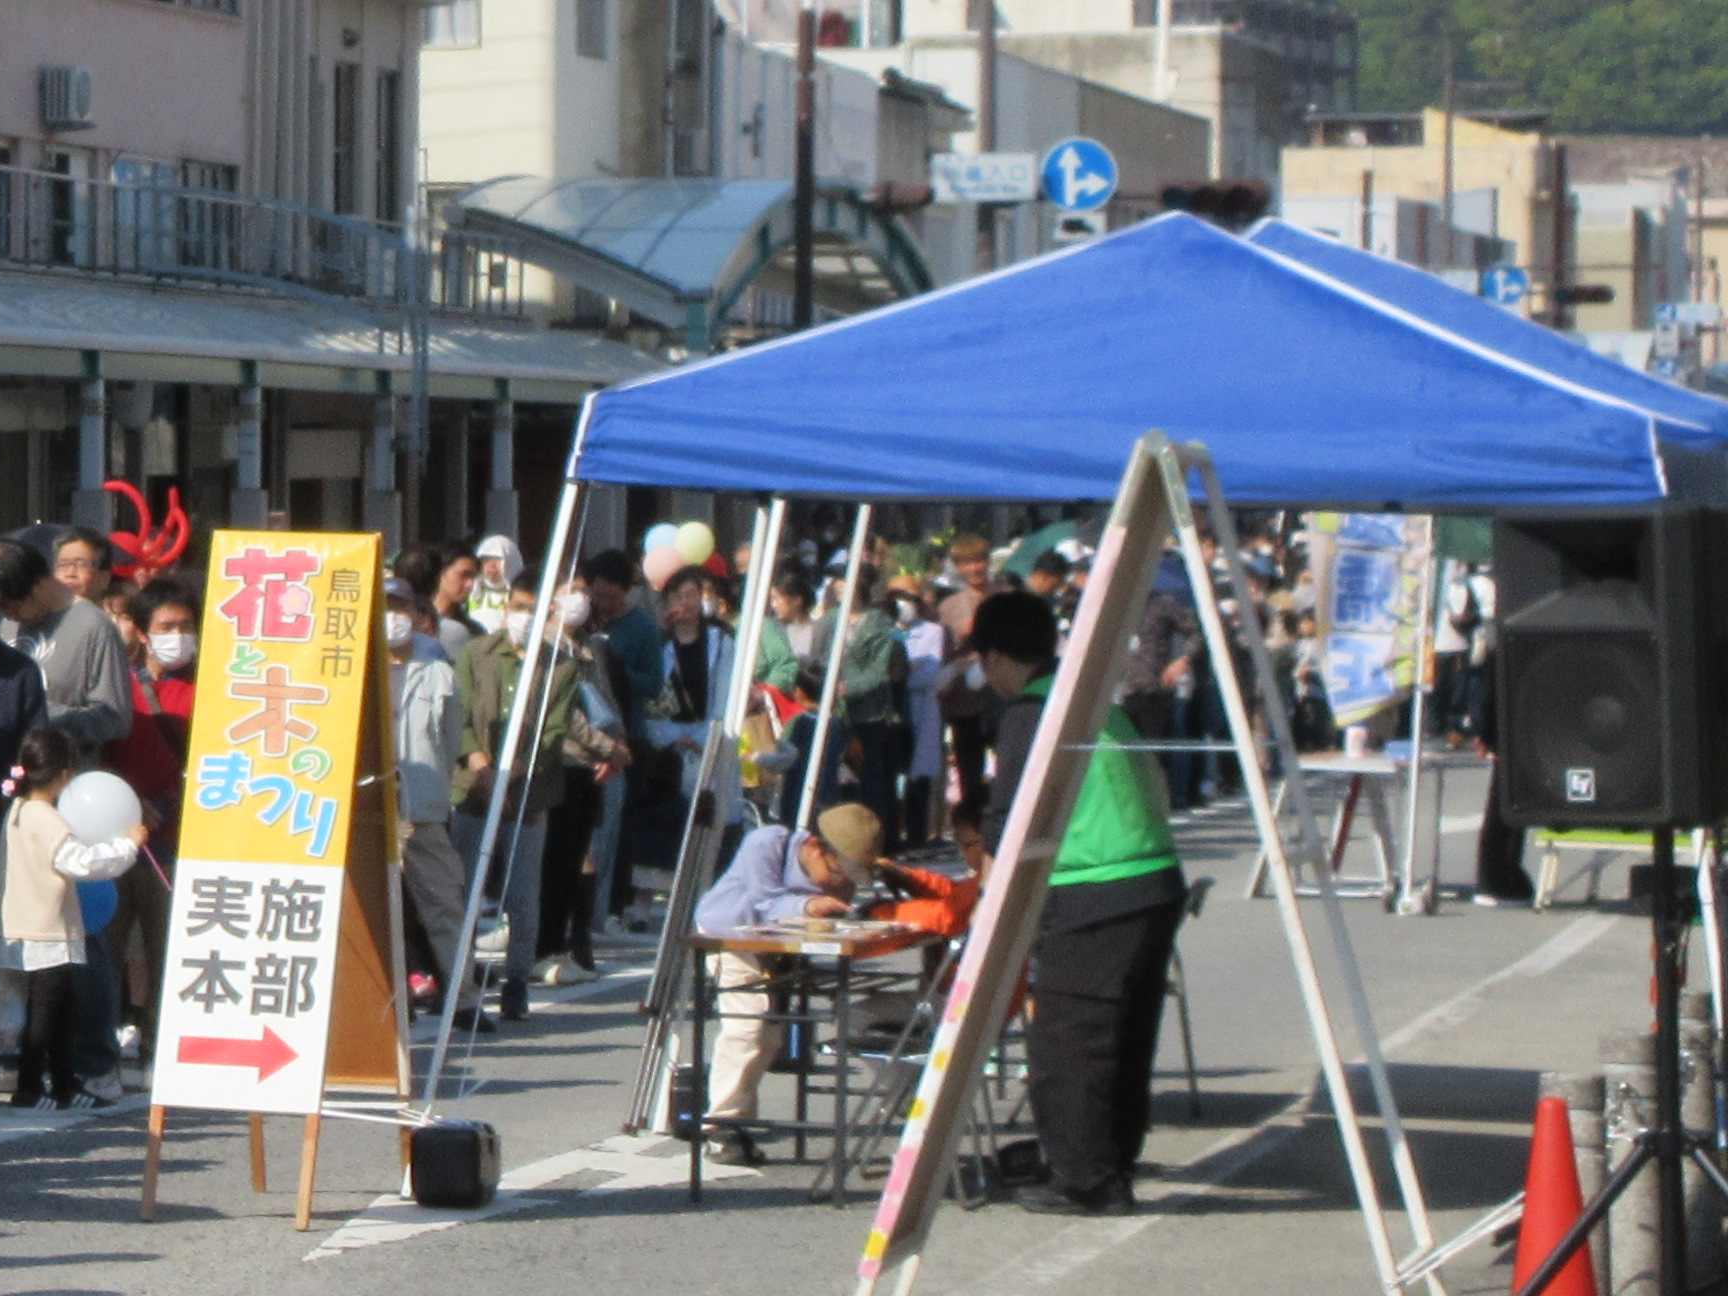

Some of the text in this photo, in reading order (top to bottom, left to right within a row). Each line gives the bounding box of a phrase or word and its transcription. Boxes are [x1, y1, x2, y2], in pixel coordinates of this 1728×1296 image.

[319, 568, 362, 680] 鳥取市
[195, 750, 341, 860] まつり
[185, 876, 327, 943] 実施
[178, 949, 317, 1019] 本部
